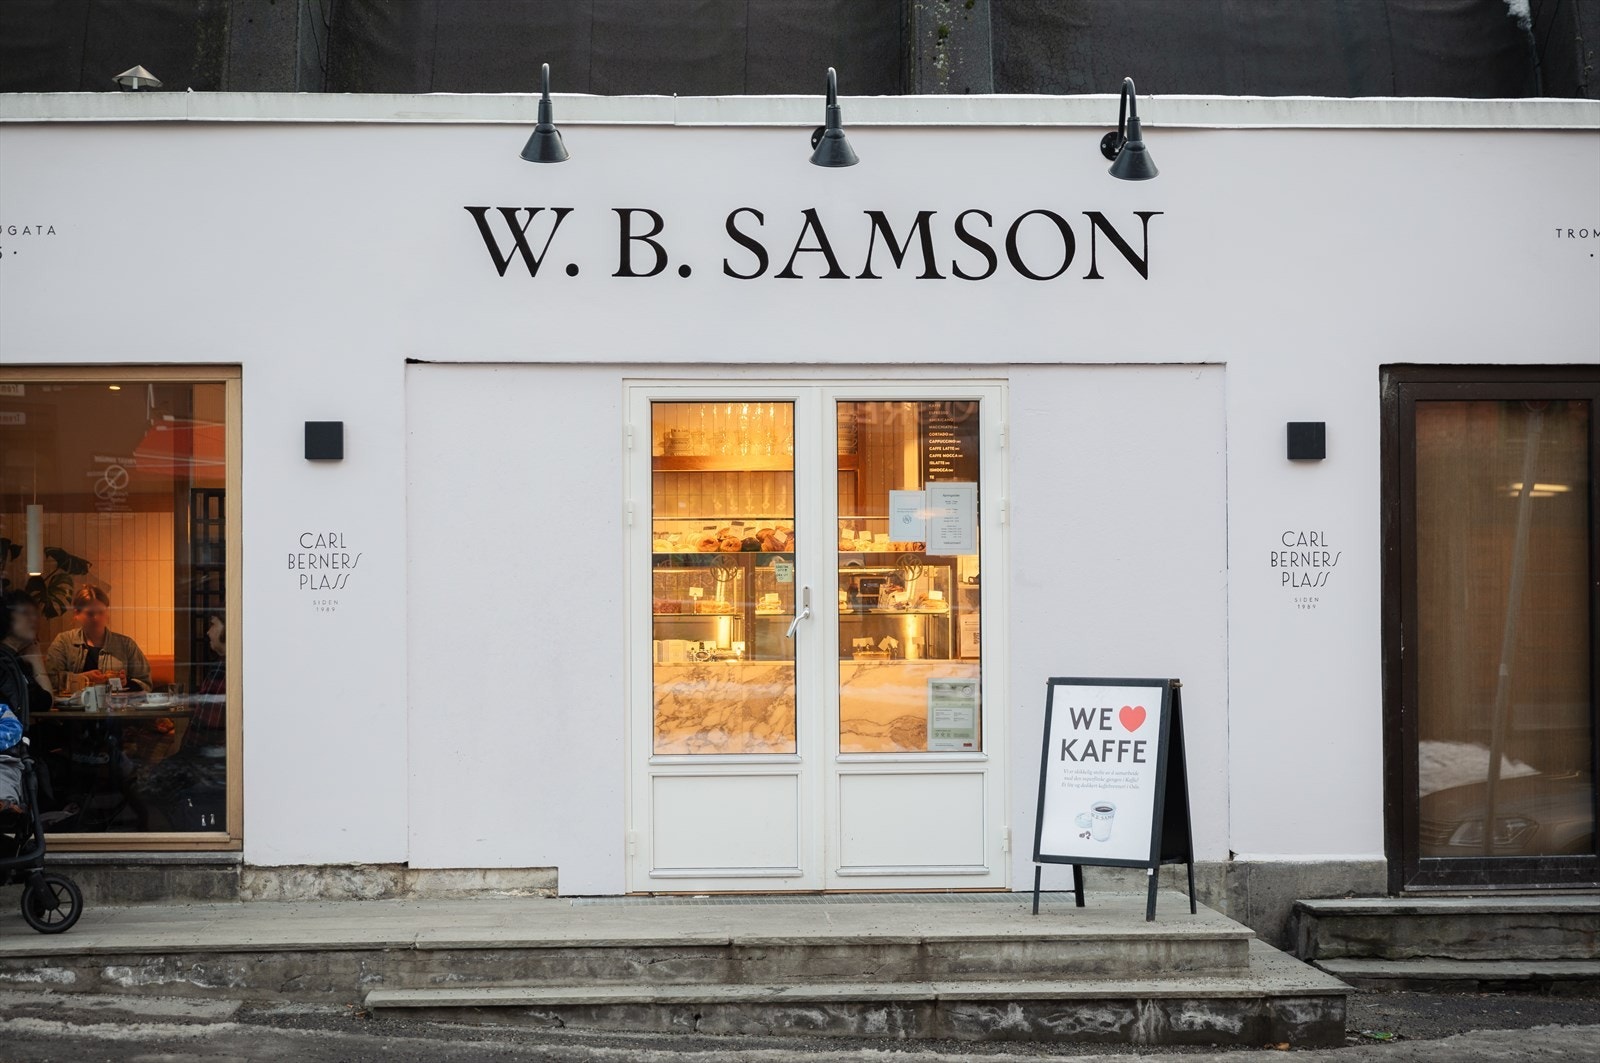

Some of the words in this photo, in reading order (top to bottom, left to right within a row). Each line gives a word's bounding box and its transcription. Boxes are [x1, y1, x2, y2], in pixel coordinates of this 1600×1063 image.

[0, 225, 57, 236] GATA
[463, 206, 580, 278] W.
[611, 207, 692, 279] B.
[723, 207, 1165, 281] SAMSON
[299, 531, 347, 549] CARL
[1281, 530, 1329, 547] CARL
[288, 552, 363, 570] BERNERS
[1270, 551, 1342, 568] BERNERS
[299, 573, 351, 590] PLASS
[1281, 571, 1331, 588] PLASS
[1069, 707, 1114, 731] WE
[1060, 738, 1147, 764] KAFFE
